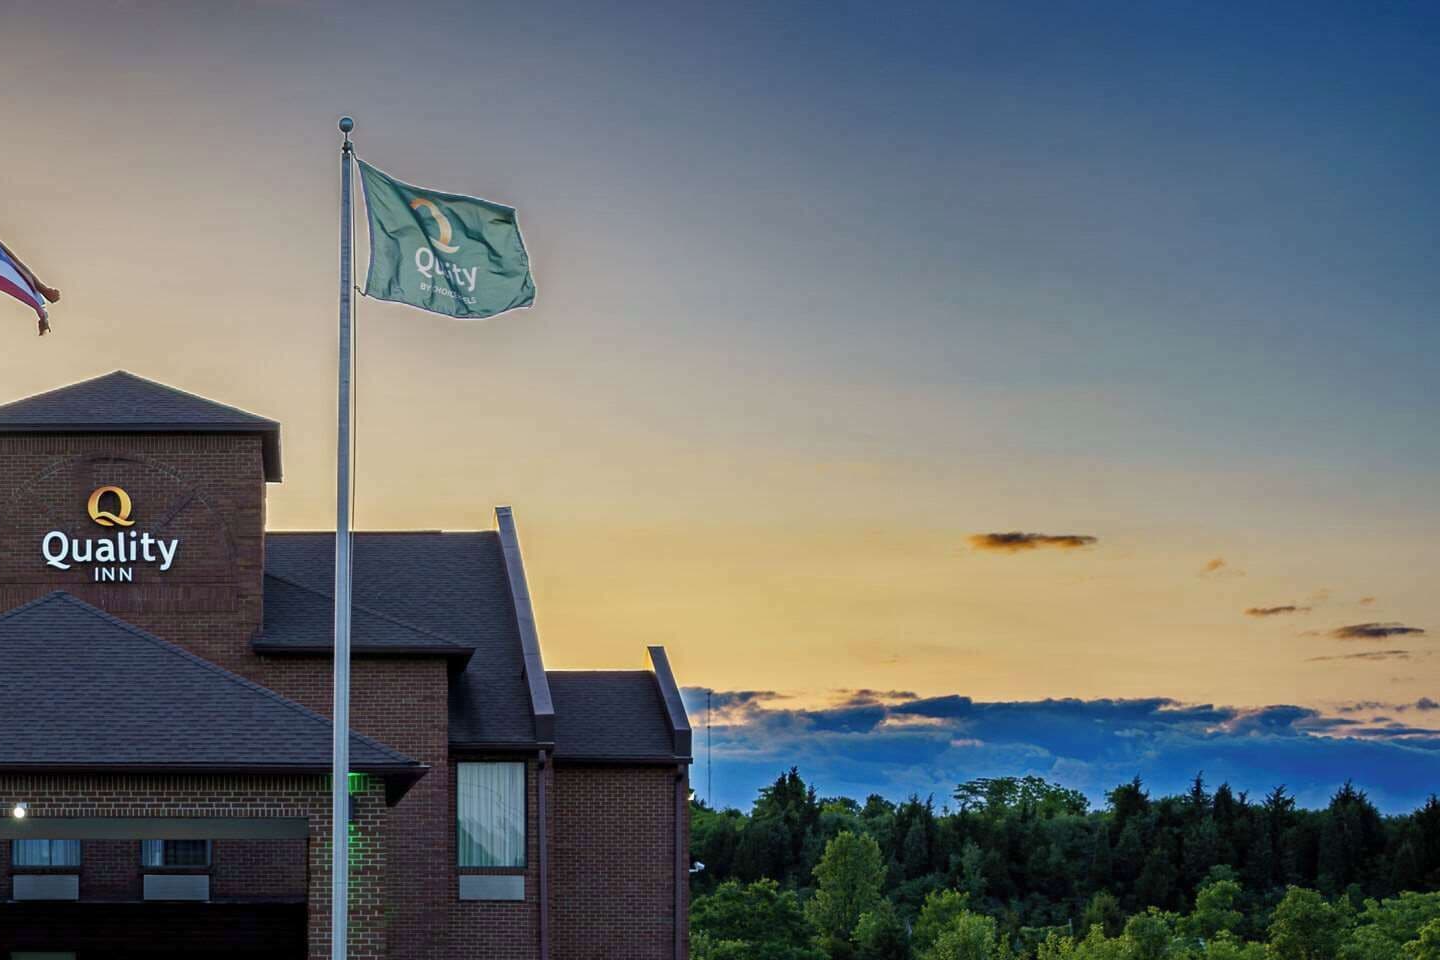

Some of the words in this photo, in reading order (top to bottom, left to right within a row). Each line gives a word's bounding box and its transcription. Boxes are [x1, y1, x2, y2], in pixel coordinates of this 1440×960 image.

[415, 247, 478, 292] Quity
[87, 485, 136, 527] Q
[42, 530, 179, 571] Quality
[94, 567, 132, 582] INN
